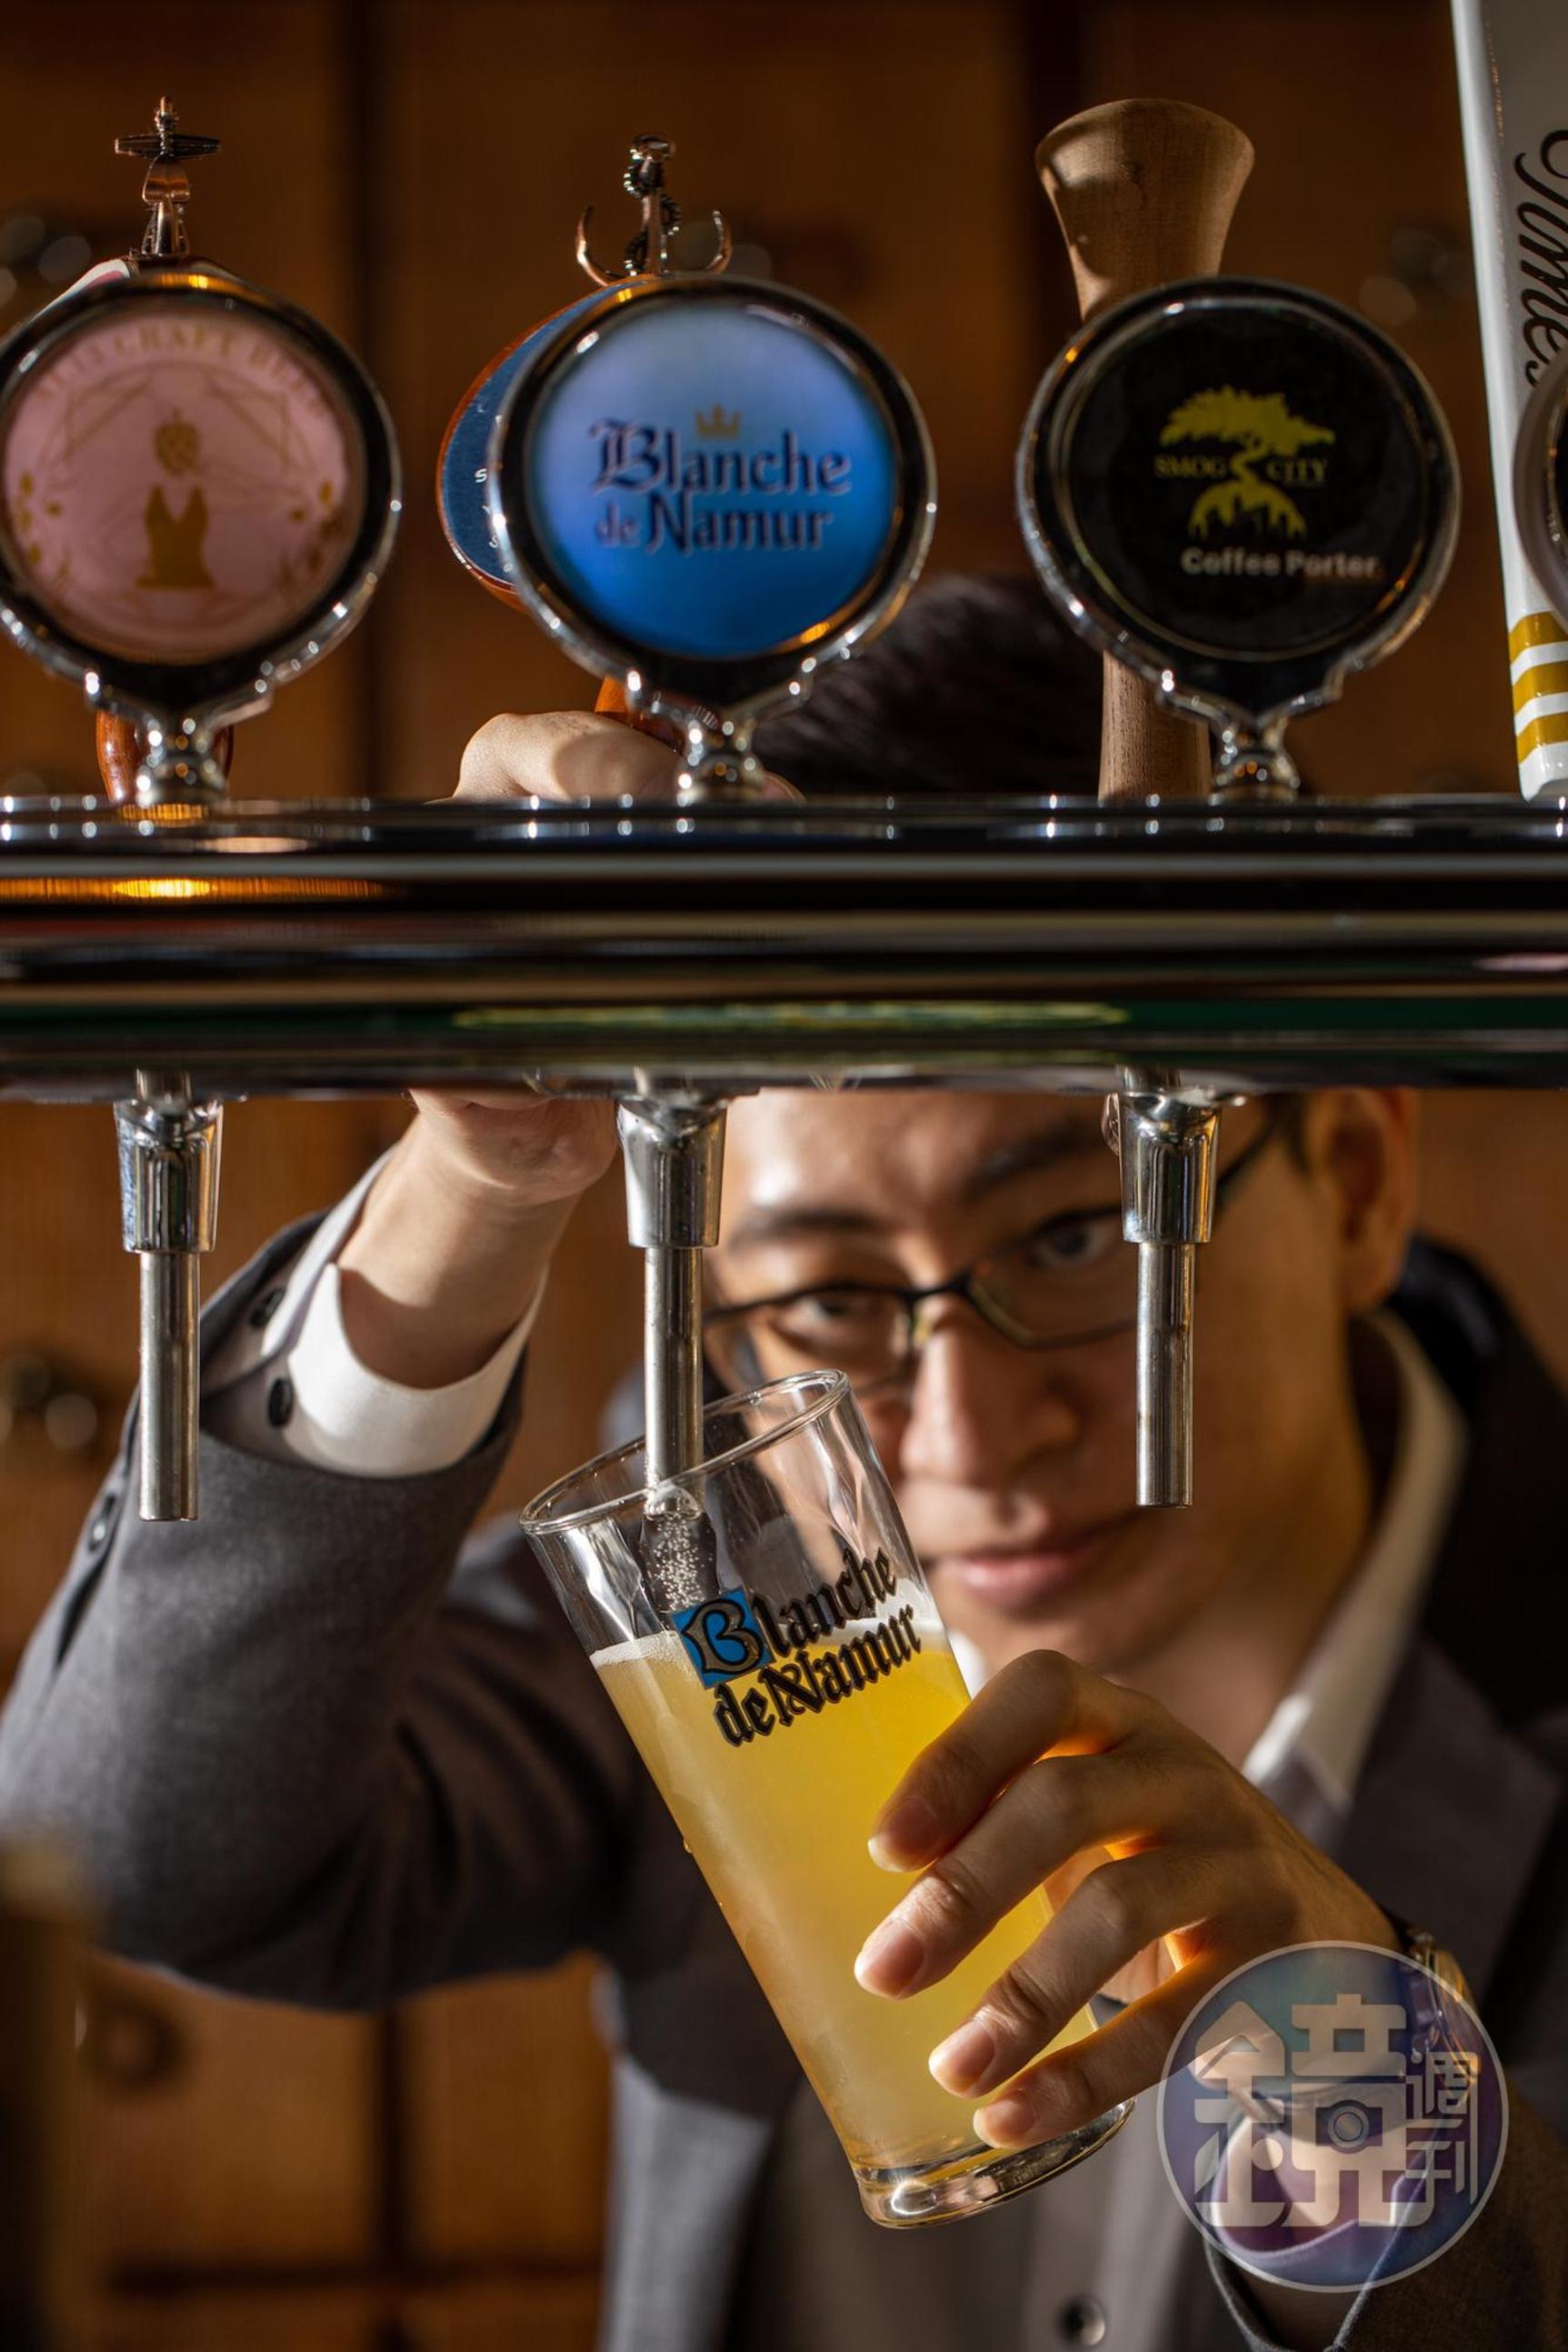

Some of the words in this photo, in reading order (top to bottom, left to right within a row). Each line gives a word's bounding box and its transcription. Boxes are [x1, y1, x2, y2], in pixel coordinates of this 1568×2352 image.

[589, 417, 853, 495] Blanche
[595, 498, 638, 546] de
[644, 487, 834, 556] Namur
[1181, 546, 1281, 576] Coffee
[1284, 550, 1379, 580] Porter
[678, 1546, 896, 1675] Blanche
[714, 1682, 775, 1747] de
[757, 1604, 921, 1726] Namur
